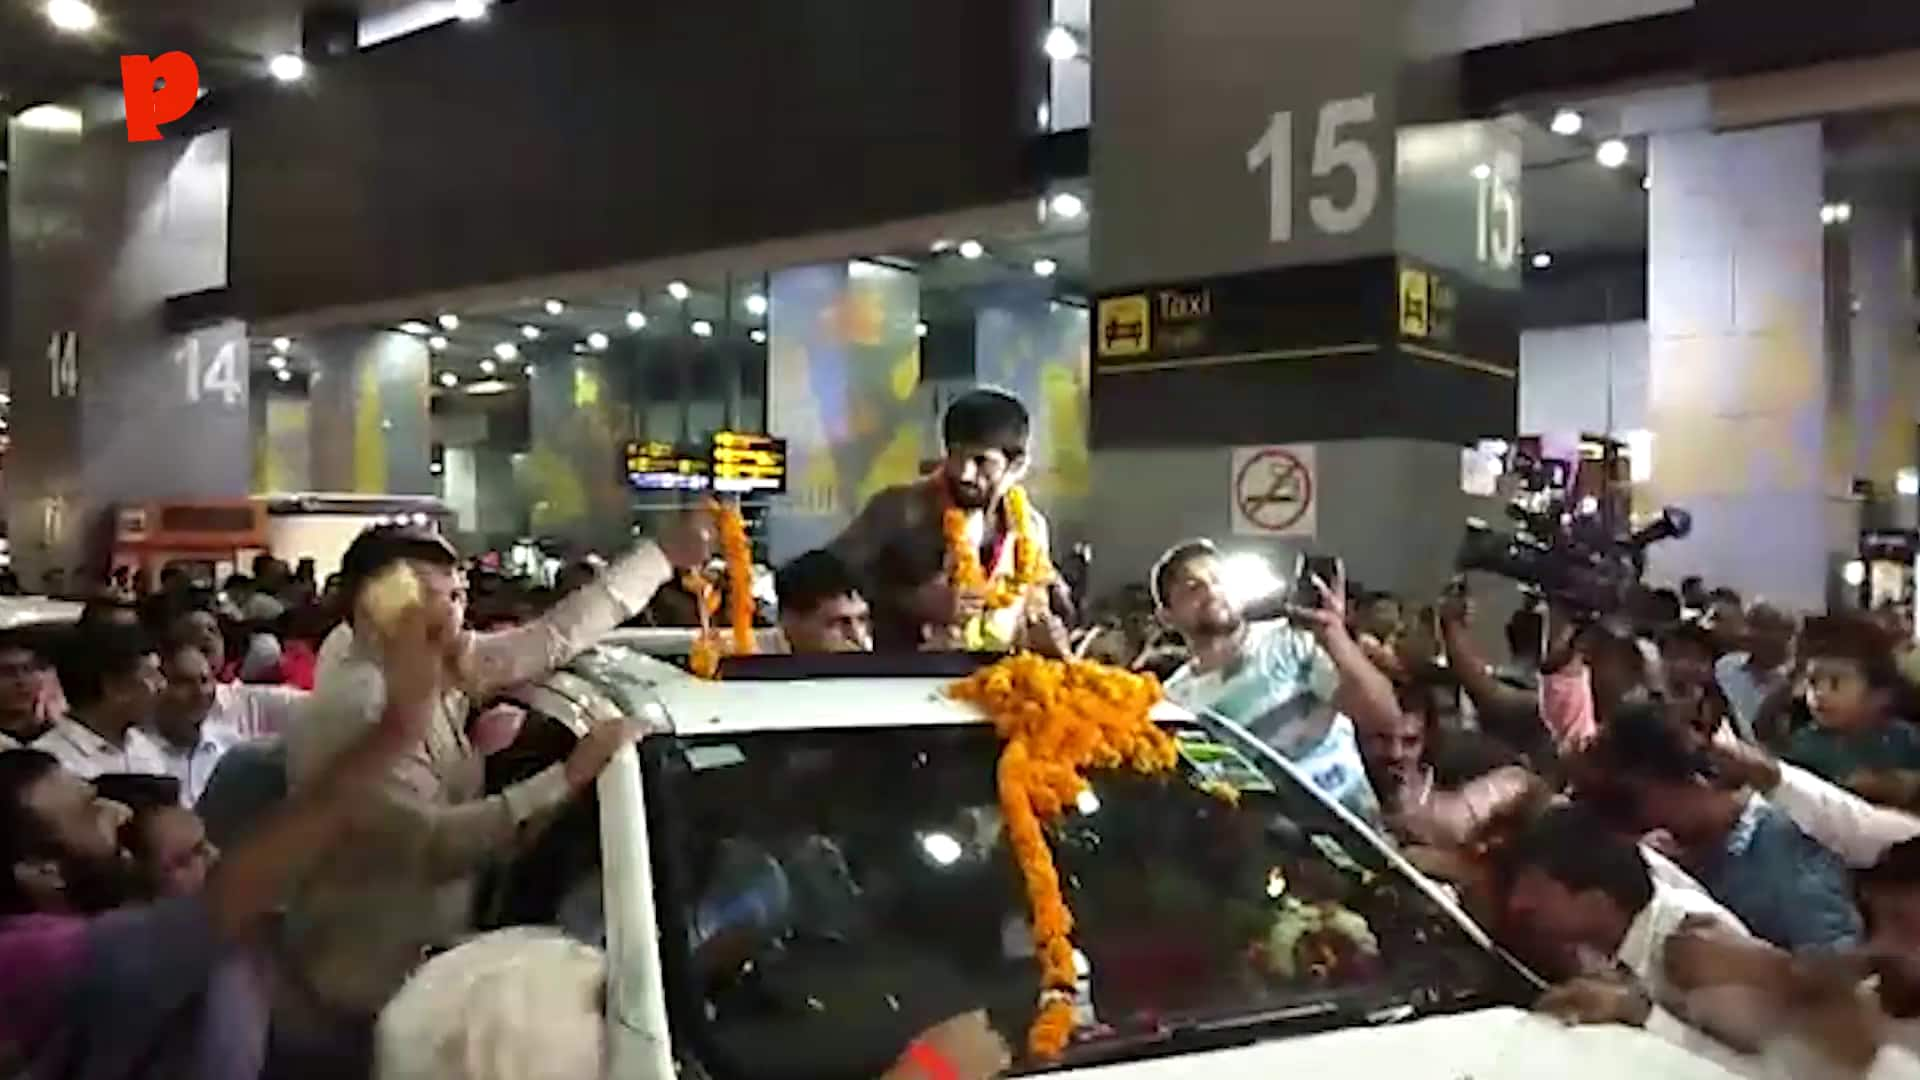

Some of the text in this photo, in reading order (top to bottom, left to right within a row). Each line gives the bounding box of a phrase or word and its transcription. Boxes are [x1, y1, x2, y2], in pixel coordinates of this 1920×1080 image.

[1245, 94, 1379, 242] 15
[1474, 162, 1516, 270] 15
[48, 331, 78, 397] 14
[174, 337, 243, 405] 14
